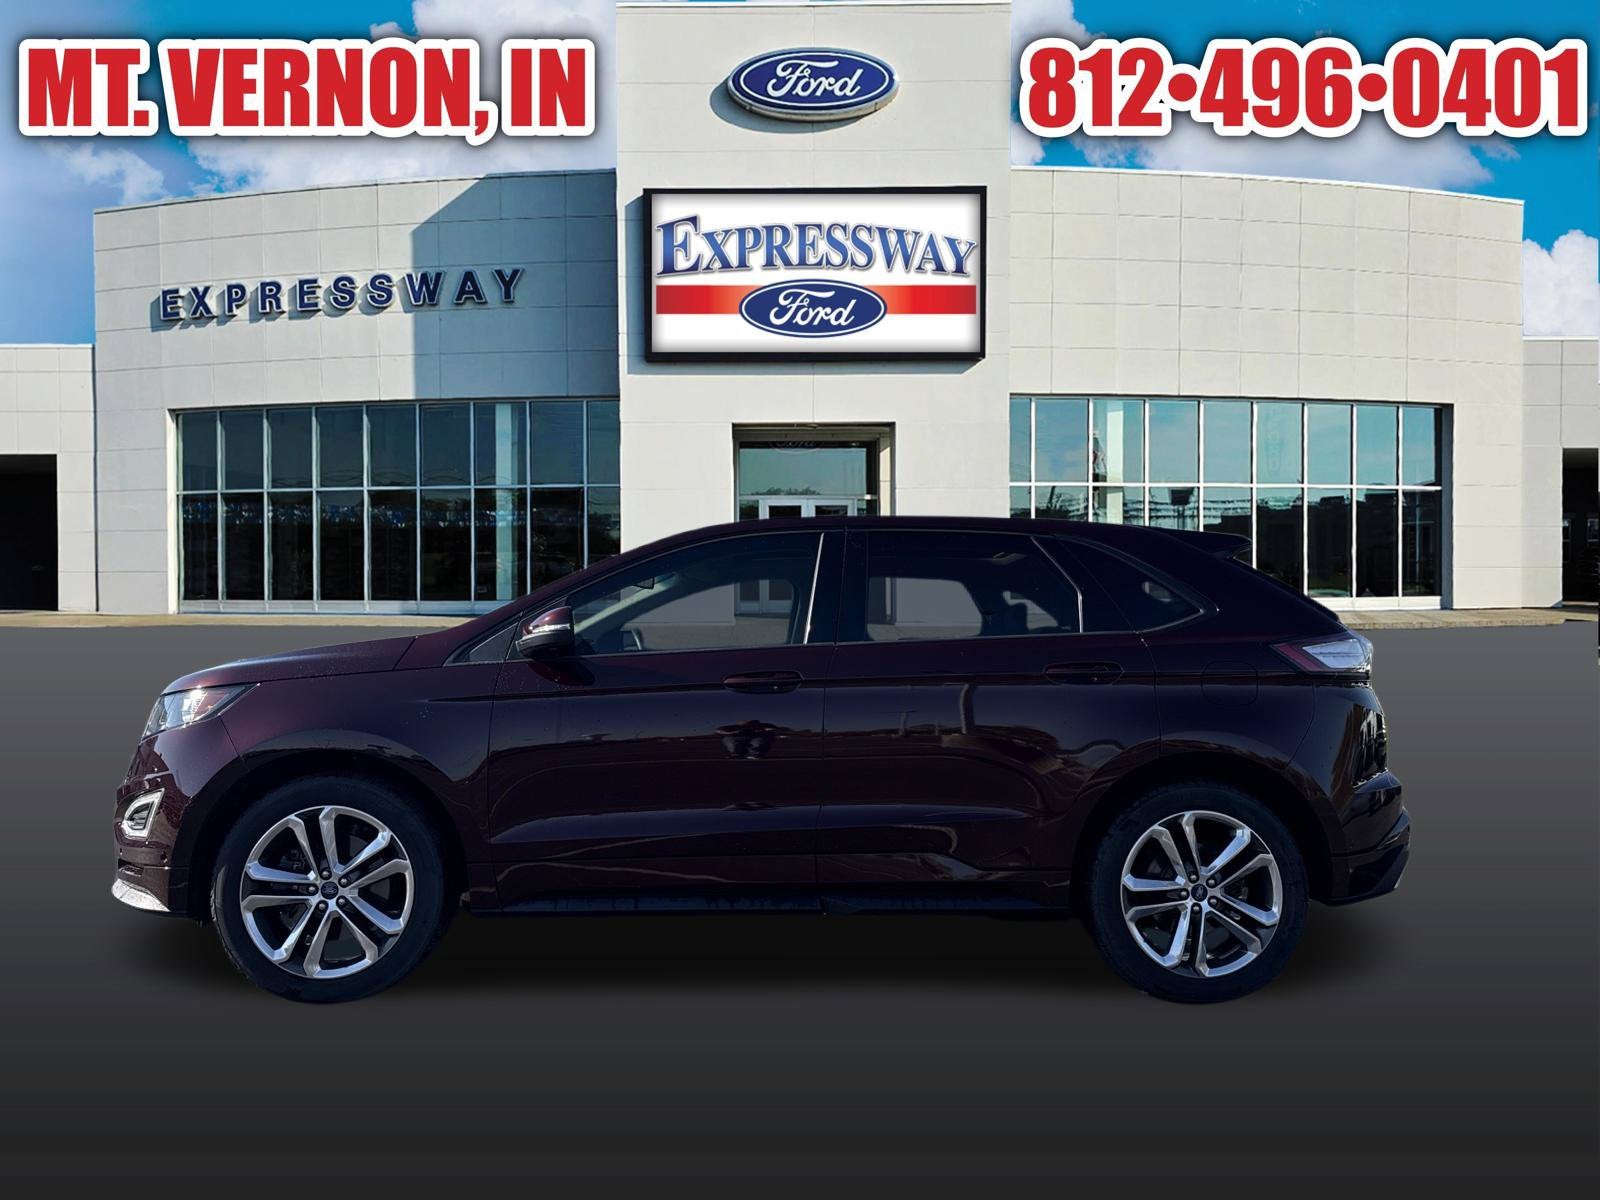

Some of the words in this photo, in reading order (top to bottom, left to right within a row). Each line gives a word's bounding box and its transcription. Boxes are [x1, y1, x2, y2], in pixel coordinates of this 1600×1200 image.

[767, 60, 863, 97] Ford
[656, 215, 976, 277] EXPRESSWAY
[160, 268, 524, 320] EXPRESSWAY
[769, 289, 856, 326] Ford
